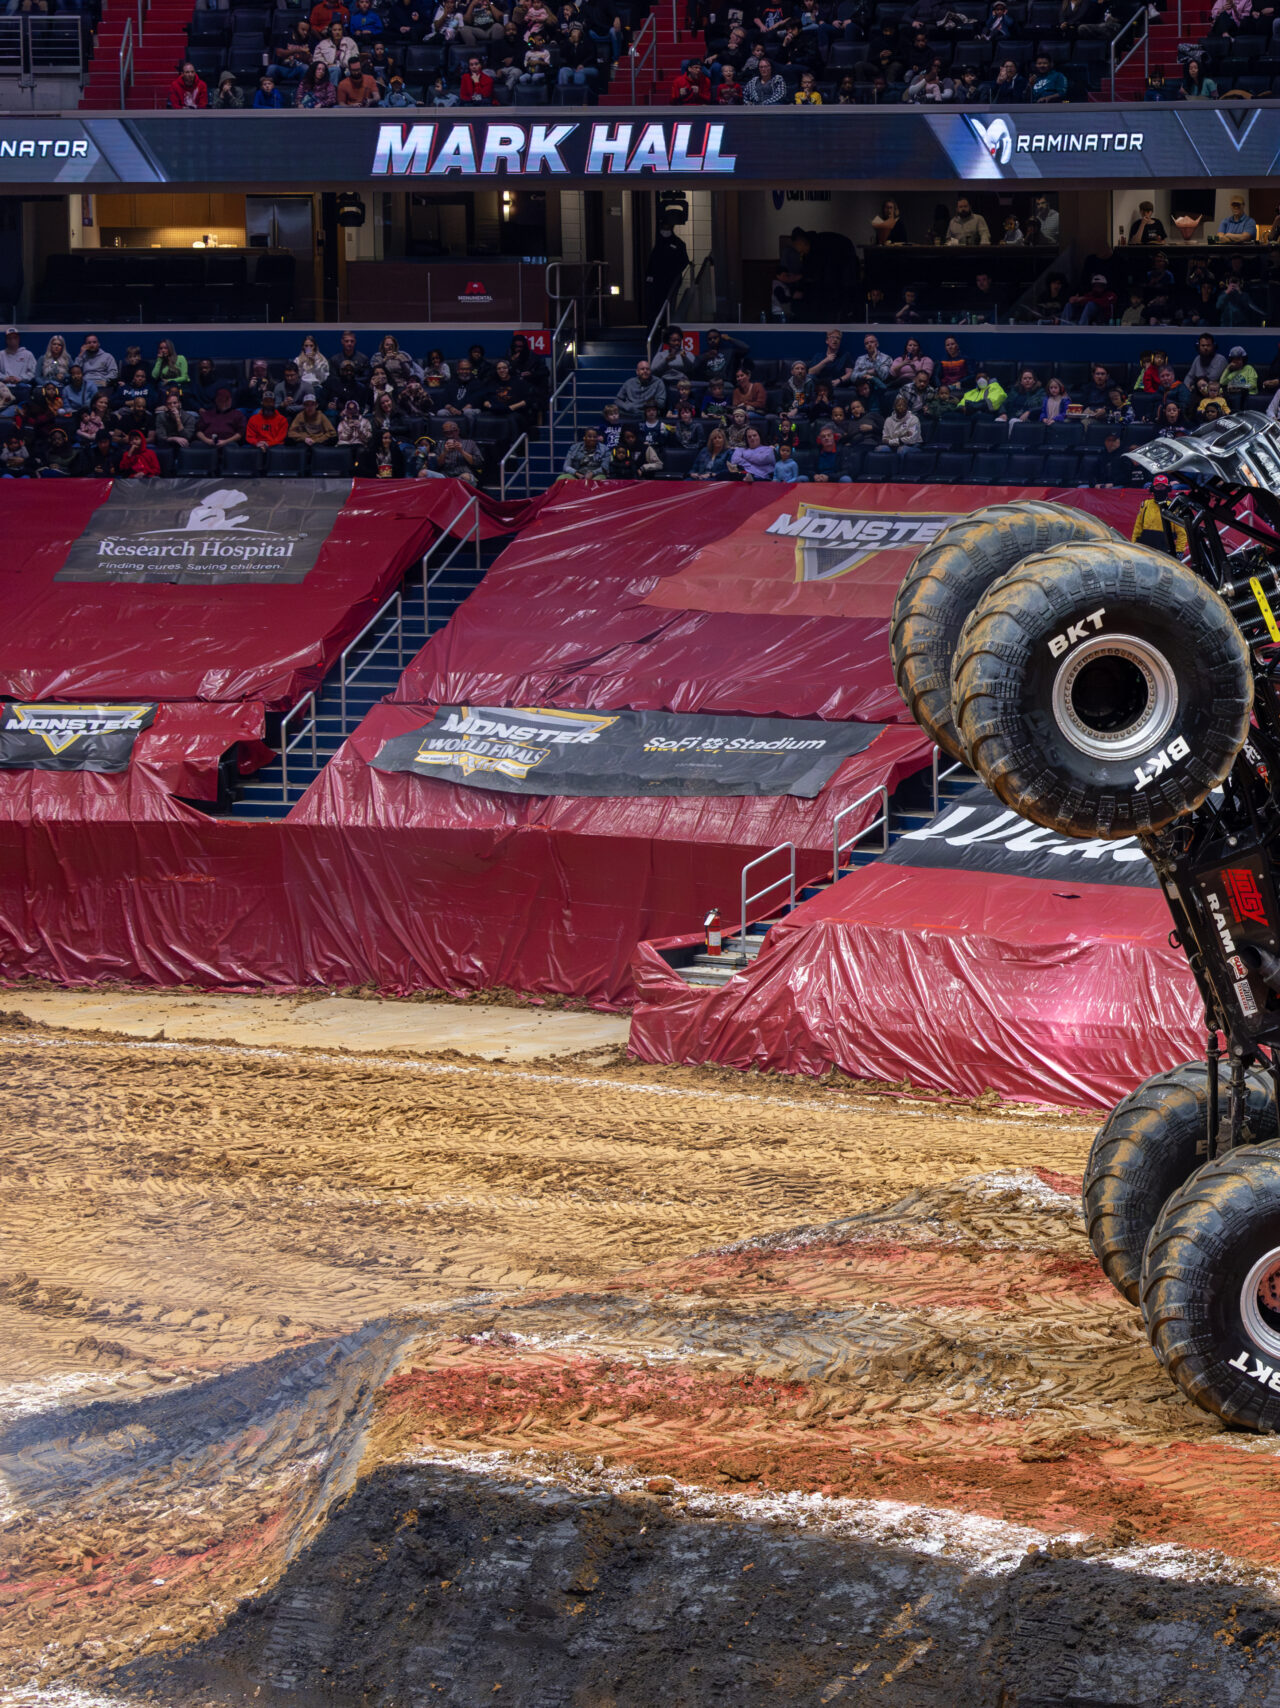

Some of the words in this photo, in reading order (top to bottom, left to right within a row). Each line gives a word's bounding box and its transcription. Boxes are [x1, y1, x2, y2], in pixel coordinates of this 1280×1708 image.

[371, 123, 579, 175] MARK
[585, 123, 737, 174] HALL
[1016, 132, 1144, 153] RAMINATOR
[528, 336, 545, 350] 14
[766, 513, 948, 543] MONSTE
[97, 541, 195, 557] Research
[200, 542, 294, 560] Hospital
[98, 562, 144, 571] Finding
[187, 562, 227, 571] Saving
[1048, 607, 1106, 658] BKT
[5, 719, 143, 730] MONSTER
[440, 713, 601, 744] MONSTER
[428, 738, 489, 755] WORLD
[488, 744, 544, 765] FINALS
[643, 737, 703, 750] SoFi
[724, 737, 827, 750] Stadium
[1134, 735, 1191, 792] BKT
[1206, 892, 1236, 953] RAM
